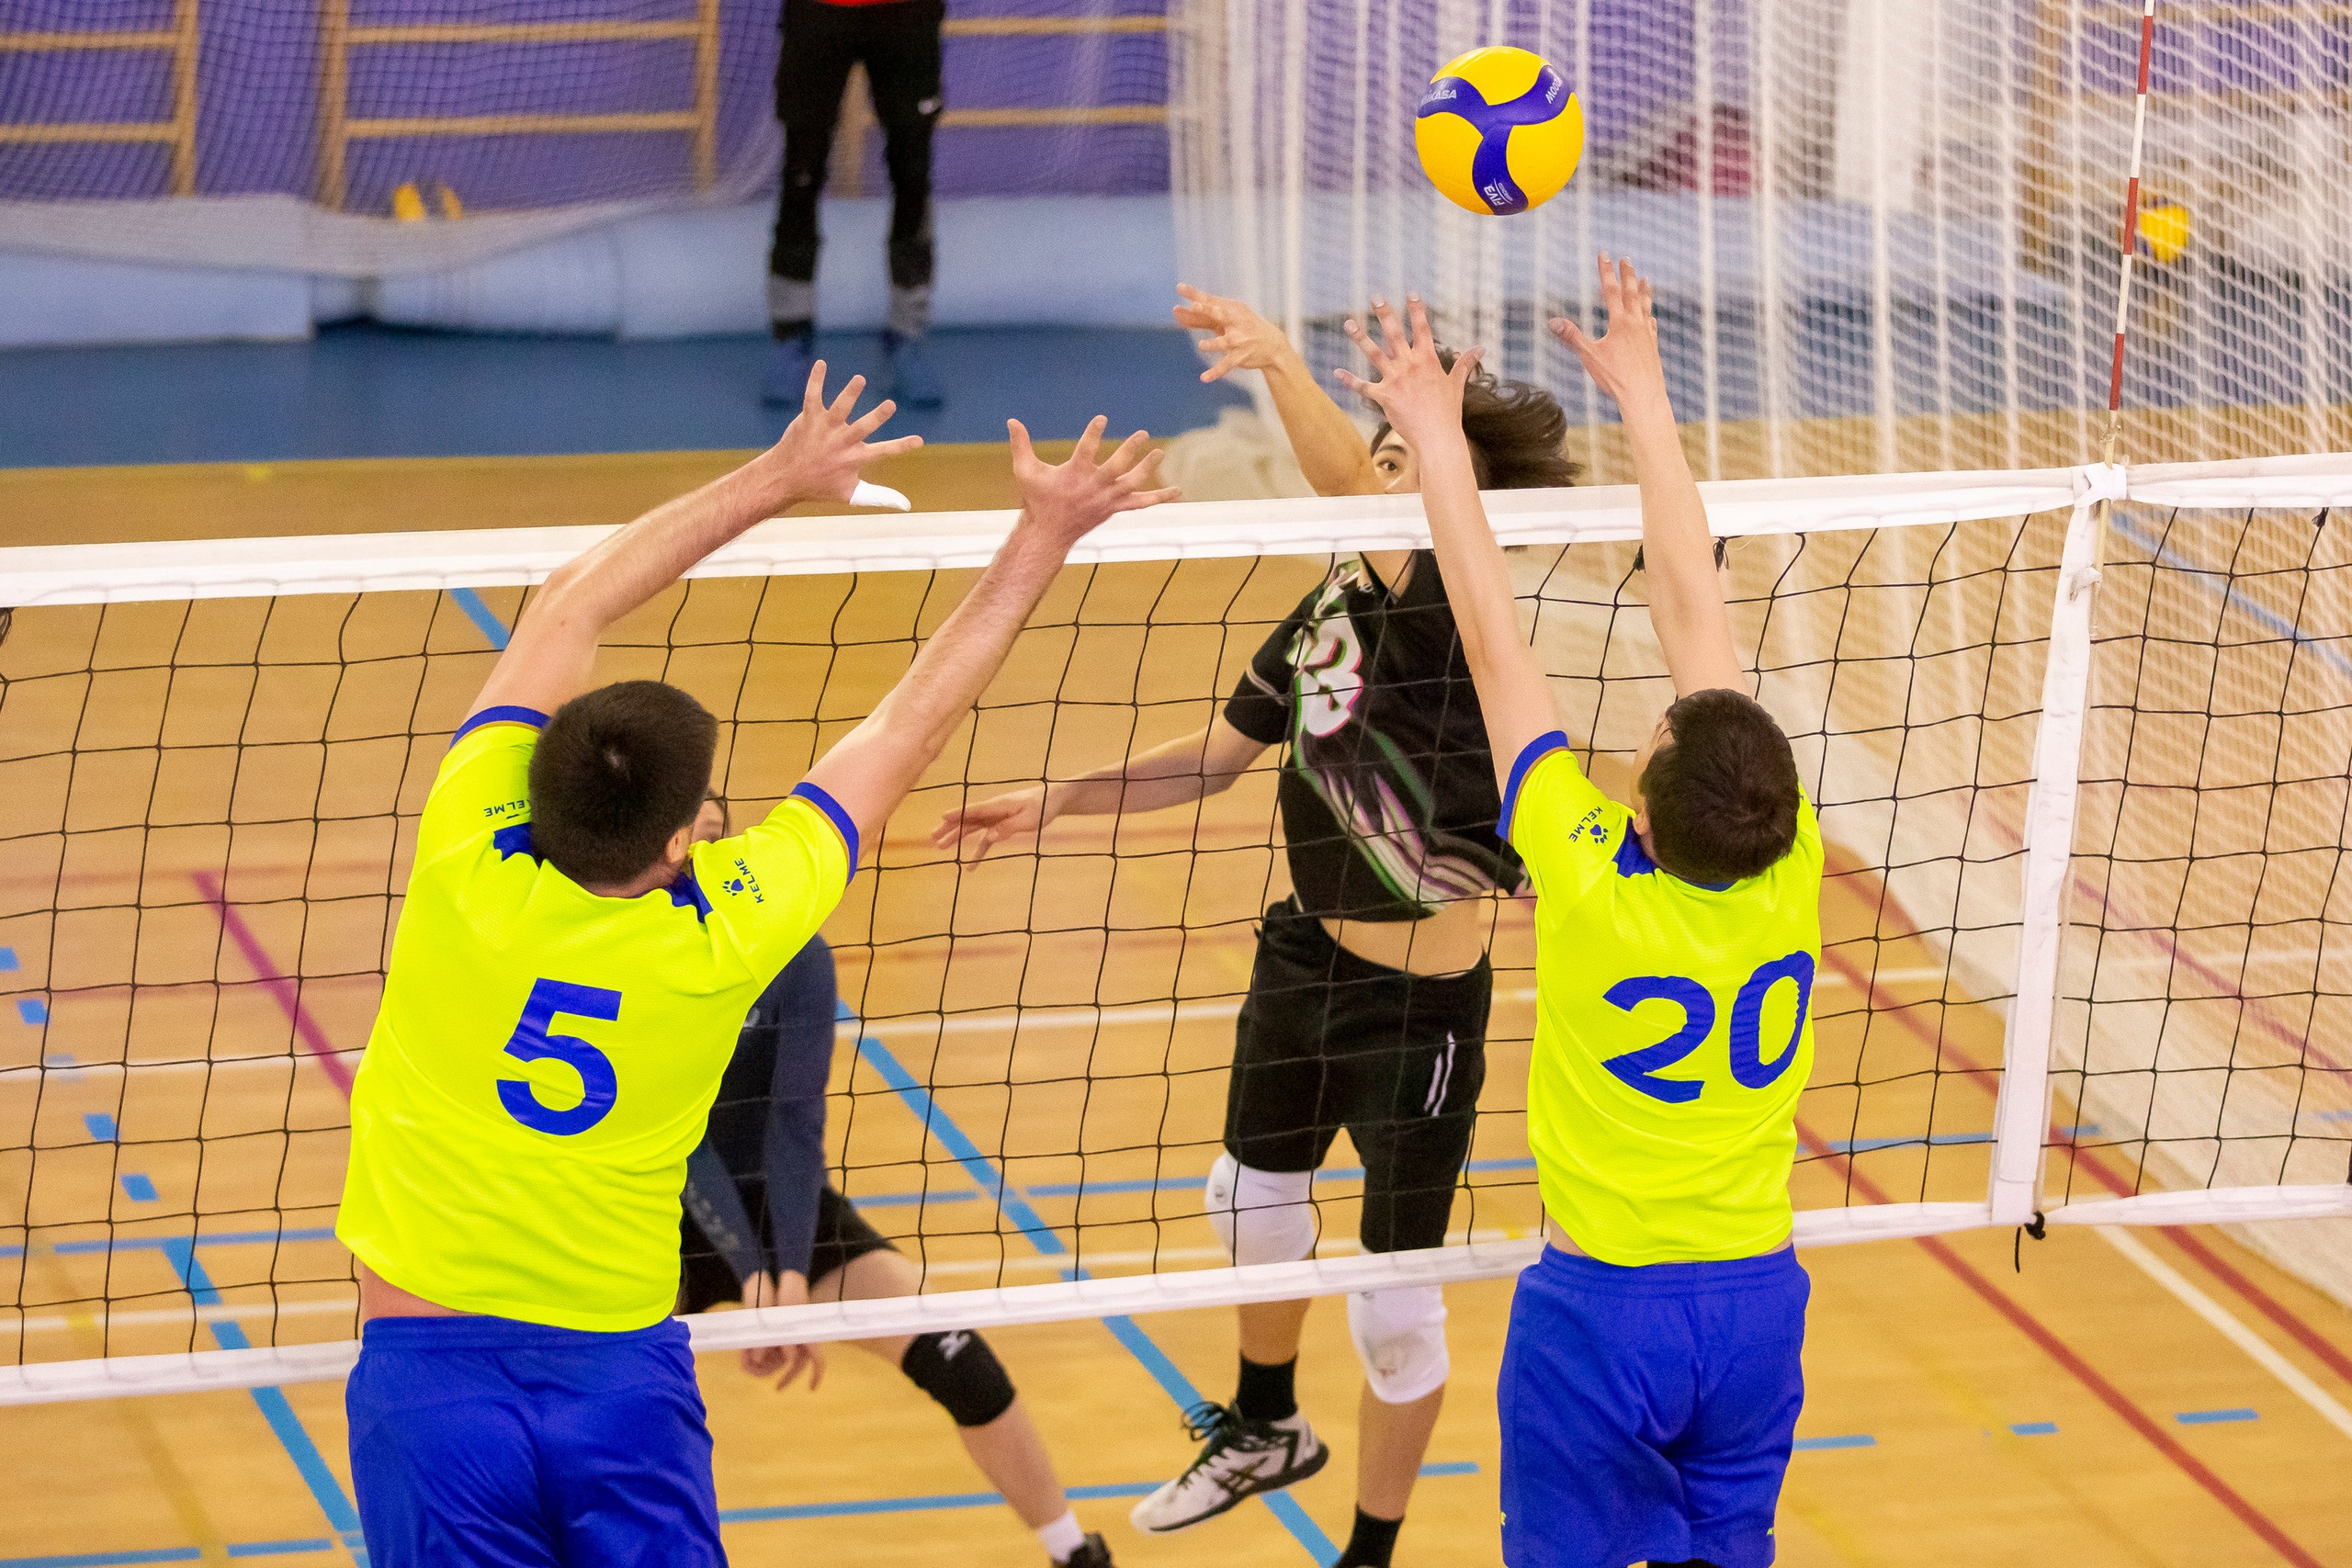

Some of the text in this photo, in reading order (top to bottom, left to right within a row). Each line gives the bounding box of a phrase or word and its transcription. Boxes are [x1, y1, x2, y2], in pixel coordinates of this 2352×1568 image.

[1568, 806, 1603, 842] KELME
[734, 857, 764, 904] KELME
[496, 977, 623, 1136] 5
[1600, 950, 1815, 1104] 20
